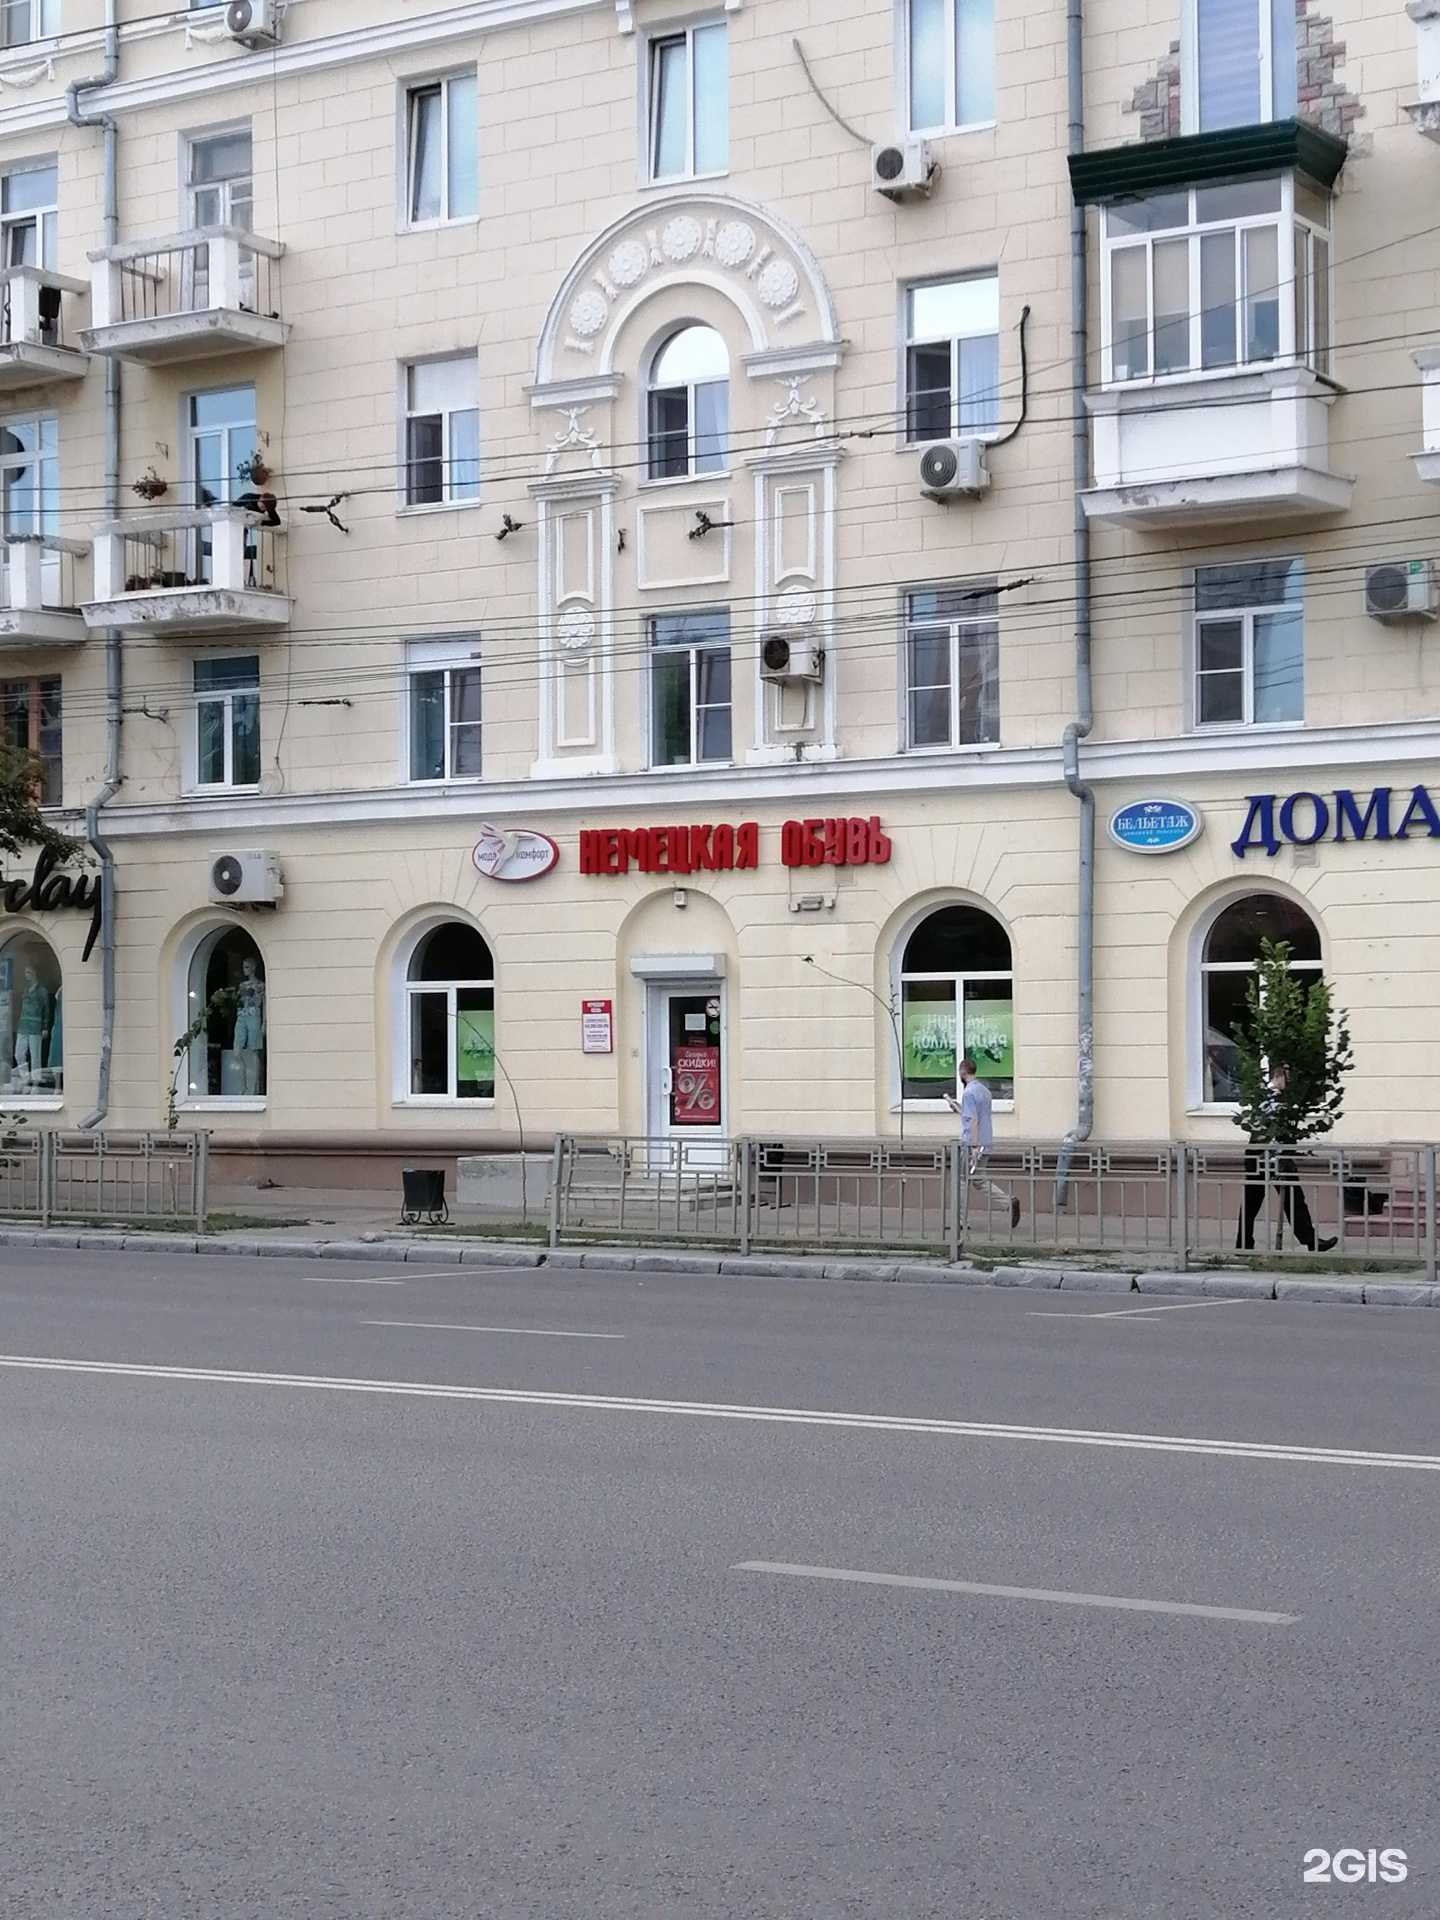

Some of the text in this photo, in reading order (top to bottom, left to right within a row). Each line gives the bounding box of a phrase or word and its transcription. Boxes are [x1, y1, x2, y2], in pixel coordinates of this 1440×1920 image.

[579, 815, 892, 875] НЕМЕЦКАЯ ОБУВЬ
[1117, 815, 1189, 830] БЕЛЬЕТАЖ
[1230, 784, 1440, 859] ДОМА
